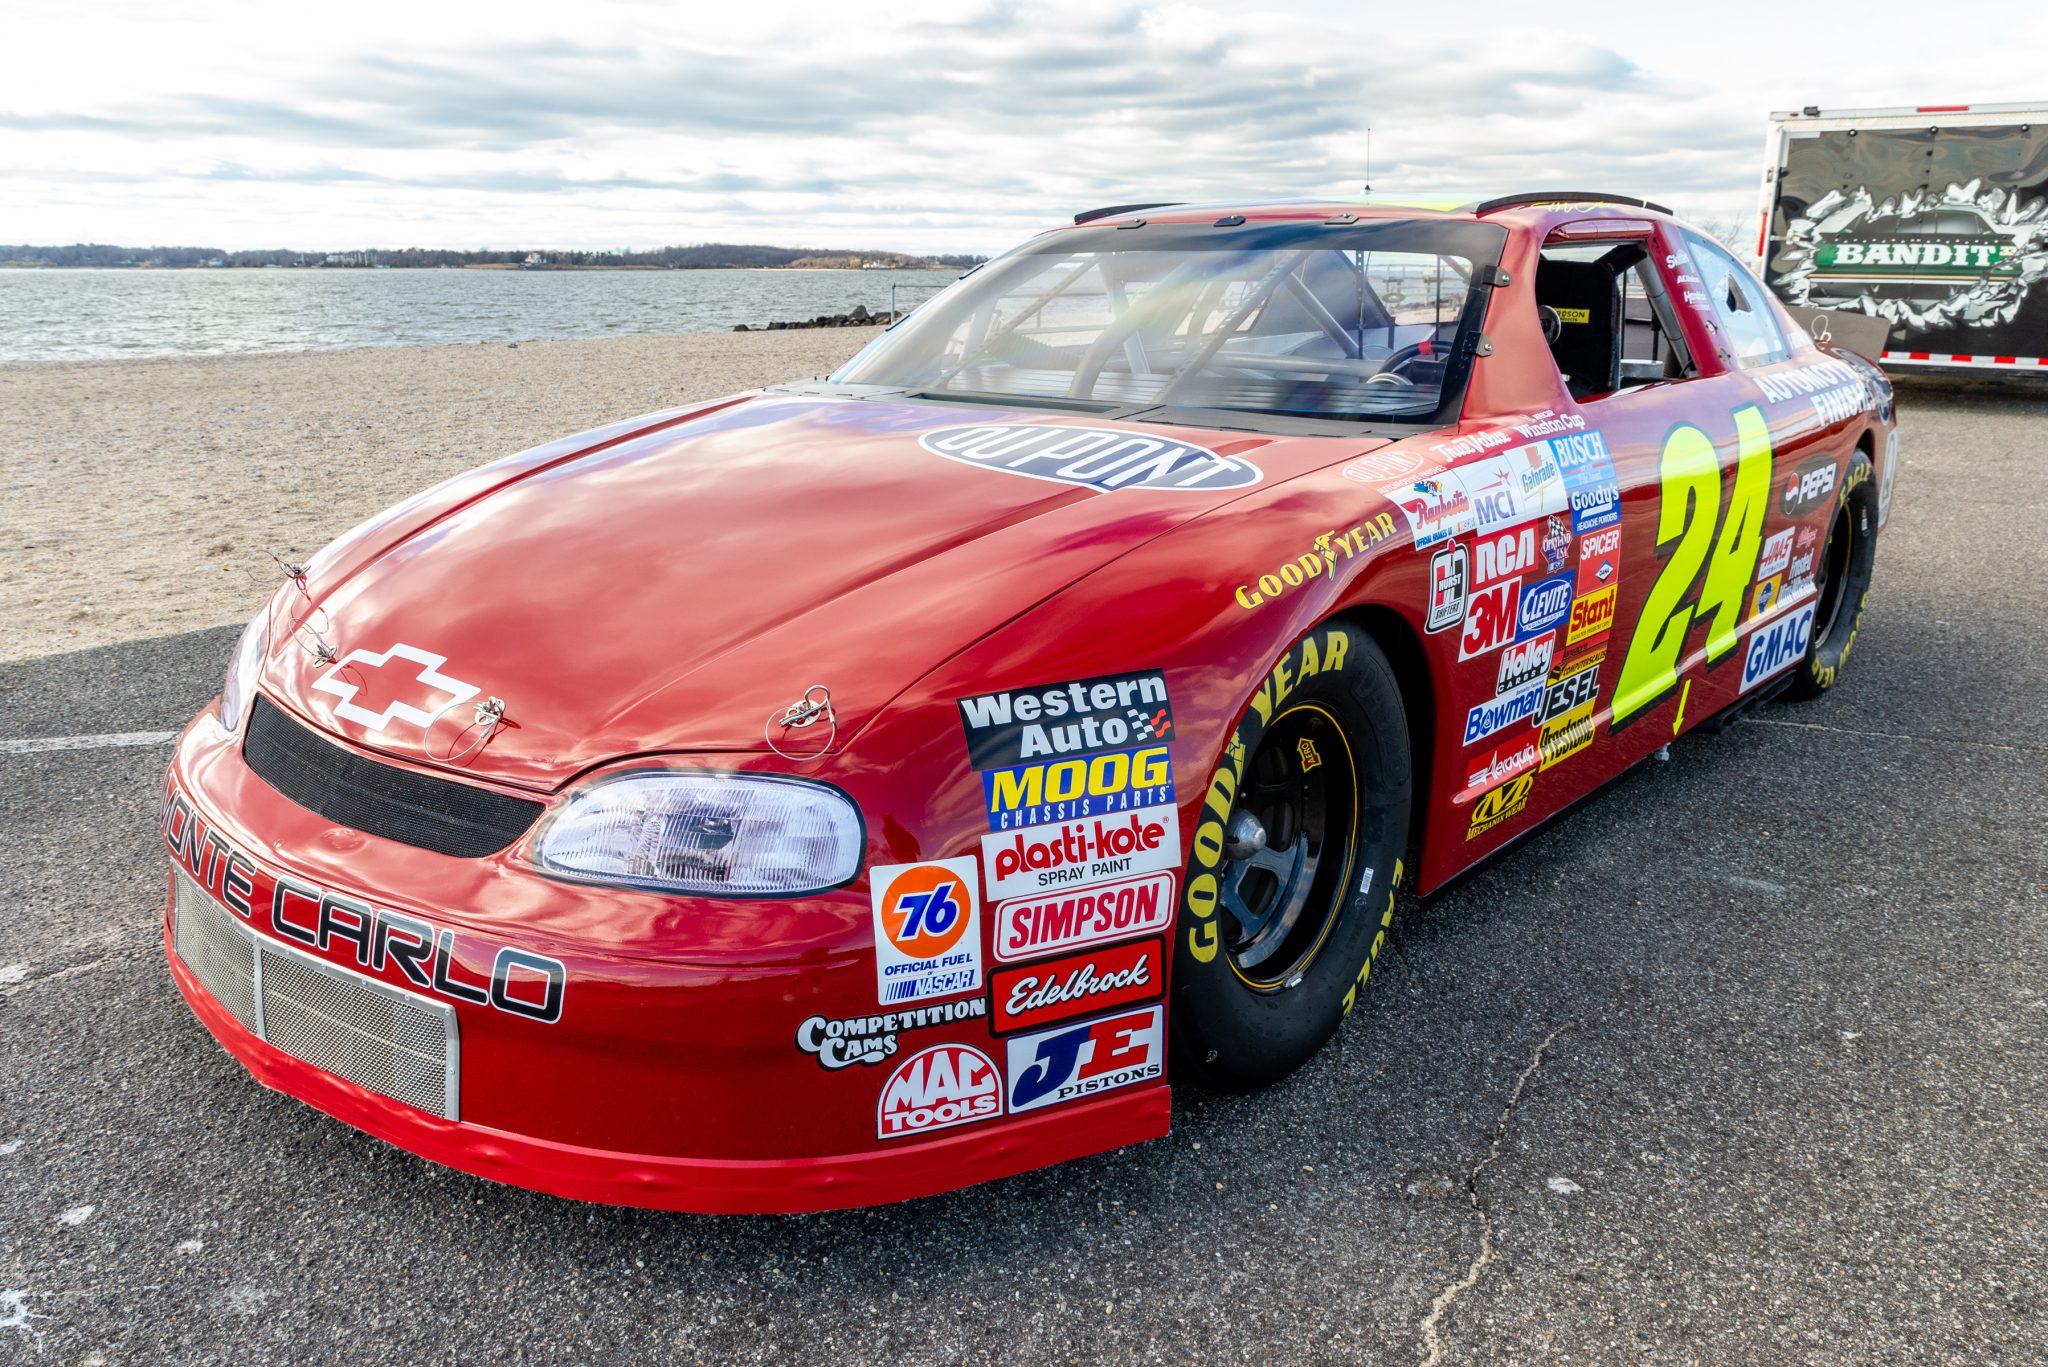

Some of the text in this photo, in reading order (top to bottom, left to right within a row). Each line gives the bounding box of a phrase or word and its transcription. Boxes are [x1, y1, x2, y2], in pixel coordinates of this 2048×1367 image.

[1833, 243, 1996, 266] BANDIT
[1513, 413, 1585, 438] Winston Cup
[1553, 431, 1608, 468] BUSCH
[1521, 460, 1556, 494] Gatorade
[1571, 482, 1620, 512] Goody's
[1798, 462, 1837, 505] PEPSI
[1474, 490, 1517, 526] MCI
[1235, 512, 1397, 610] GOODYEAR
[1475, 527, 1535, 586] RCA
[1580, 529, 1620, 561] SPICER
[1610, 403, 1773, 726] 24
[1438, 573, 1462, 592] HURST
[1521, 582, 1571, 624] CLEVITE
[1435, 602, 1460, 620] SHIFTERS
[1463, 579, 1520, 655] 3M
[1570, 589, 1615, 633] Stant
[1501, 637, 1555, 682] Holley
[1746, 608, 1813, 683] GMAC
[1498, 669, 1536, 691] CARBS
[1533, 667, 1600, 726] JESEL
[961, 676, 1168, 729] Western
[1465, 686, 1544, 742] Bowman
[1020, 716, 1128, 759] Auto
[1301, 742, 1316, 764] AERO
[990, 746, 1170, 813] MOOG
[1468, 743, 1535, 787] Aeroquip
[1001, 786, 1167, 830] CHASSIS PARTS
[1466, 797, 1528, 843] MECHANIX WEAR
[995, 813, 1166, 882] plasti-kote
[1038, 857, 1133, 887] SPRAY PAINT
[160, 769, 567, 1025] MONTE CARLO
[893, 881, 961, 942] 76
[1008, 882, 1160, 950] SIMPSON
[884, 952, 973, 977] OFFICIAL FUEL
[914, 969, 976, 997] NASCAR
[1005, 953, 1151, 1016] Edelbrock
[796, 998, 987, 1052] COMPETITION
[819, 1034, 898, 1069] CAMS
[1011, 1010, 1155, 1108] JE
[885, 1049, 997, 1112] MAC
[1057, 1063, 1161, 1099] PISTONS
[884, 1095, 997, 1132] TOOLS
